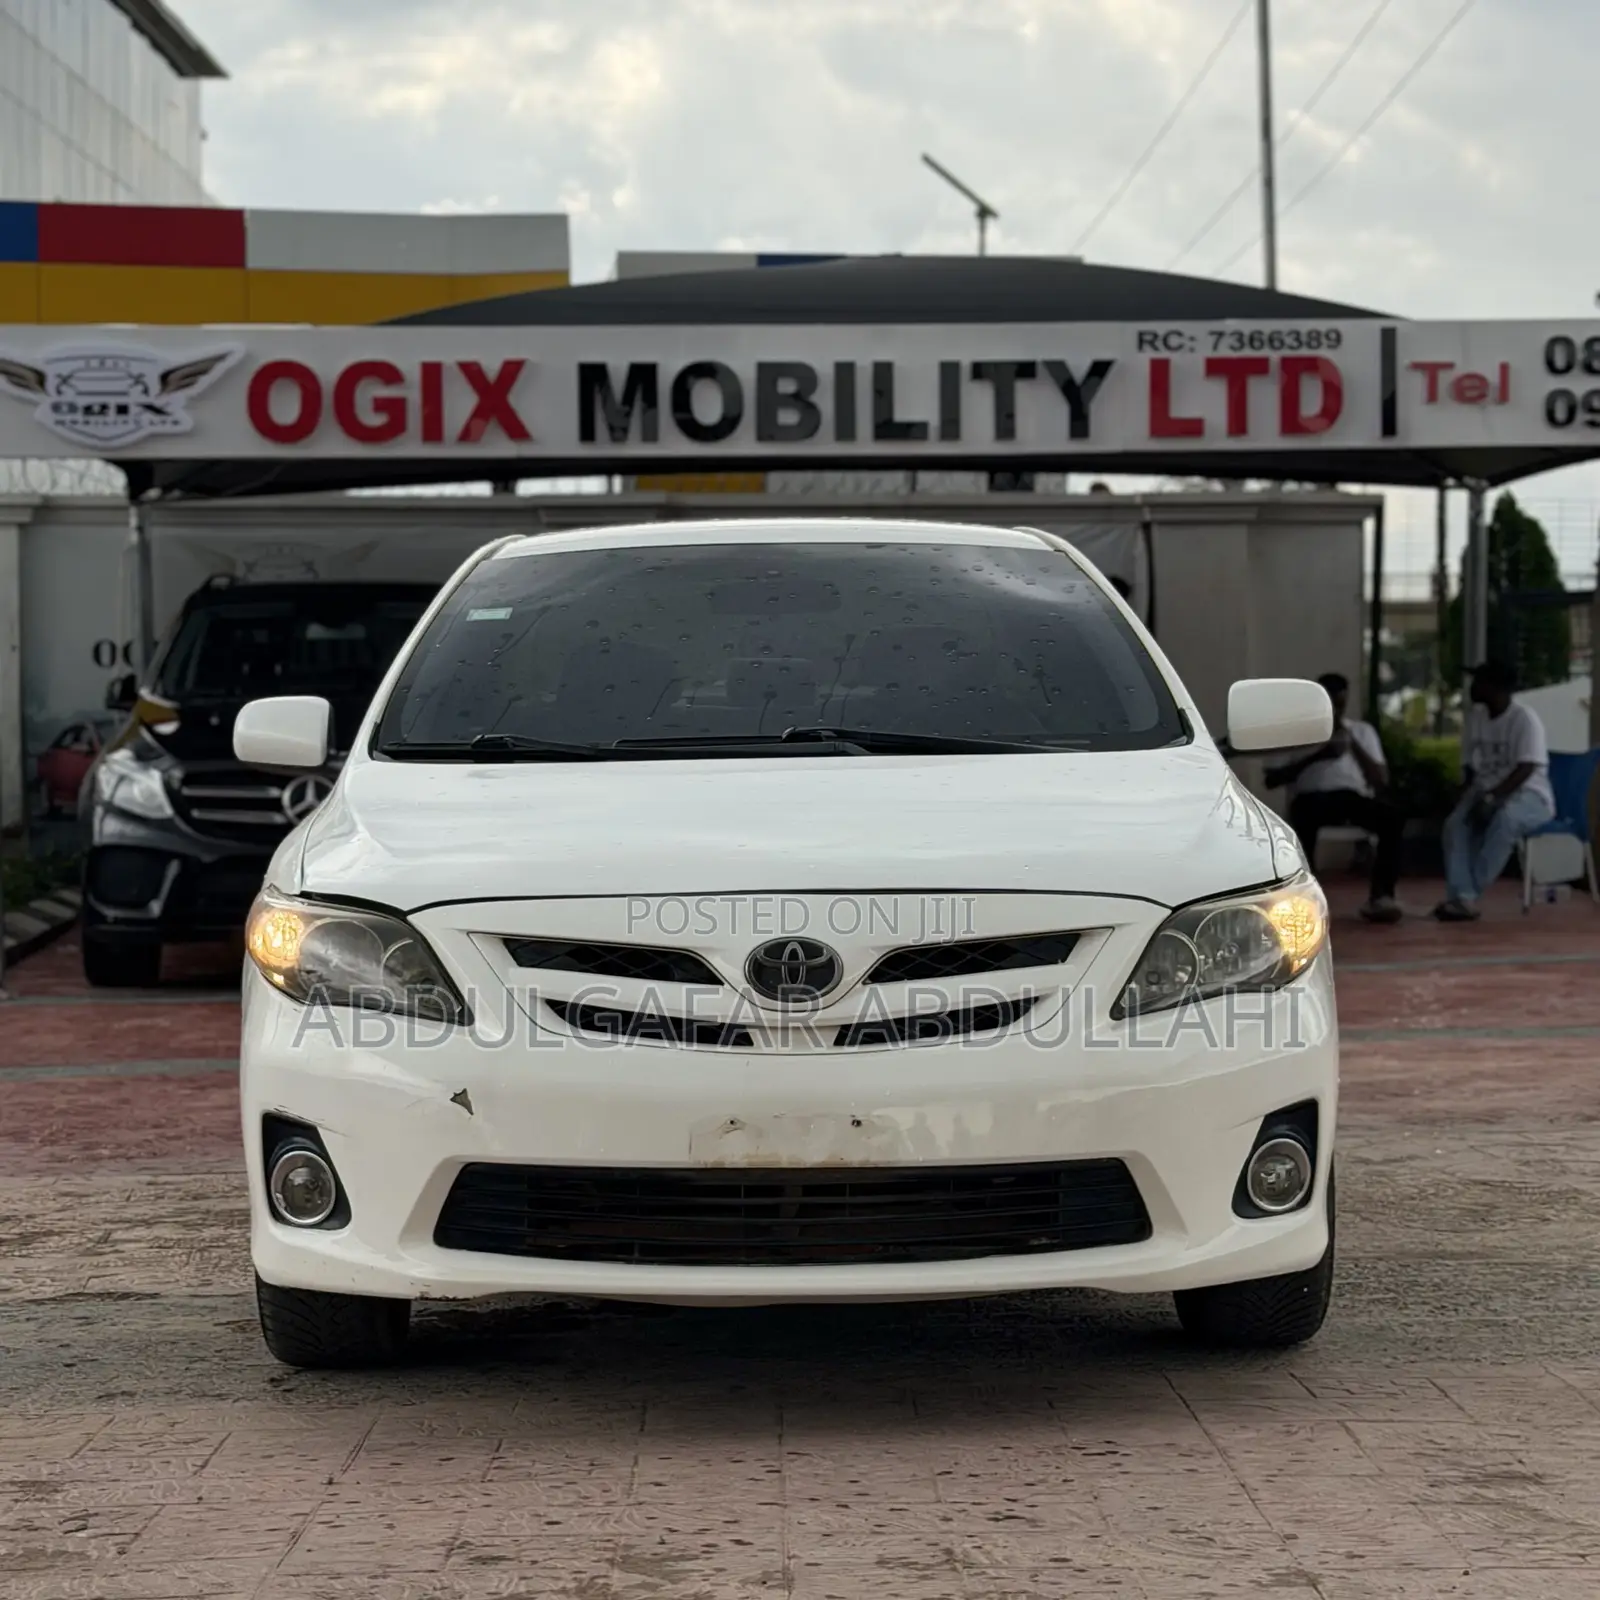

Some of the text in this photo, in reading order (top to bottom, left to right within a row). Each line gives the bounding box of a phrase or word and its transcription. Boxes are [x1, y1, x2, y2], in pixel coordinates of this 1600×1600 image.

[1137, 328, 1342, 353] RC: 7366389
[246, 356, 1344, 444] OGIX MOBILITY LTD
[1409, 361, 1511, 405] Tel
